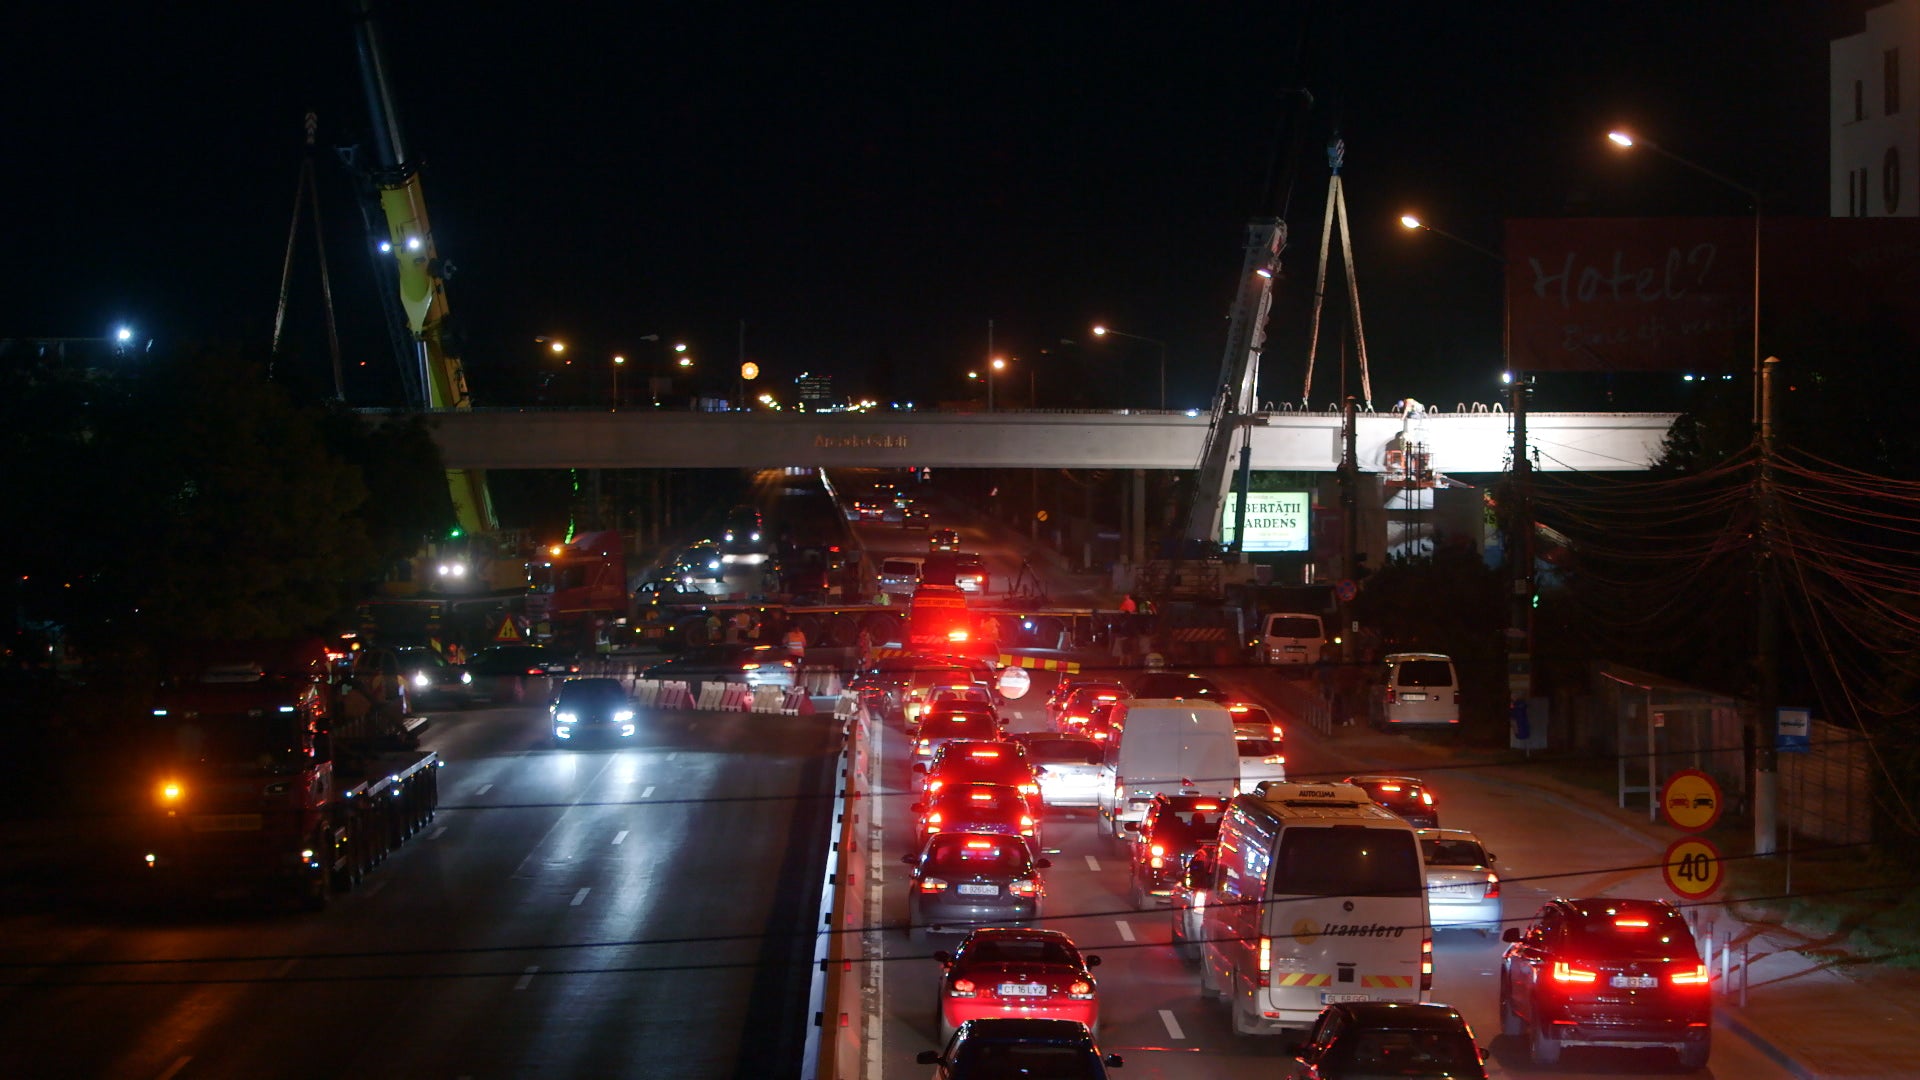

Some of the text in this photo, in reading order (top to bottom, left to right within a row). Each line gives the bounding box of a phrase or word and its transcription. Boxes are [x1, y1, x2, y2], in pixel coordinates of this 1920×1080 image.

[1528, 243, 1717, 309] Hotel?
[1678, 853, 1709, 882] 40
[1018, 986, 1026, 994] 16
[1027, 986, 1045, 994] LYZ
